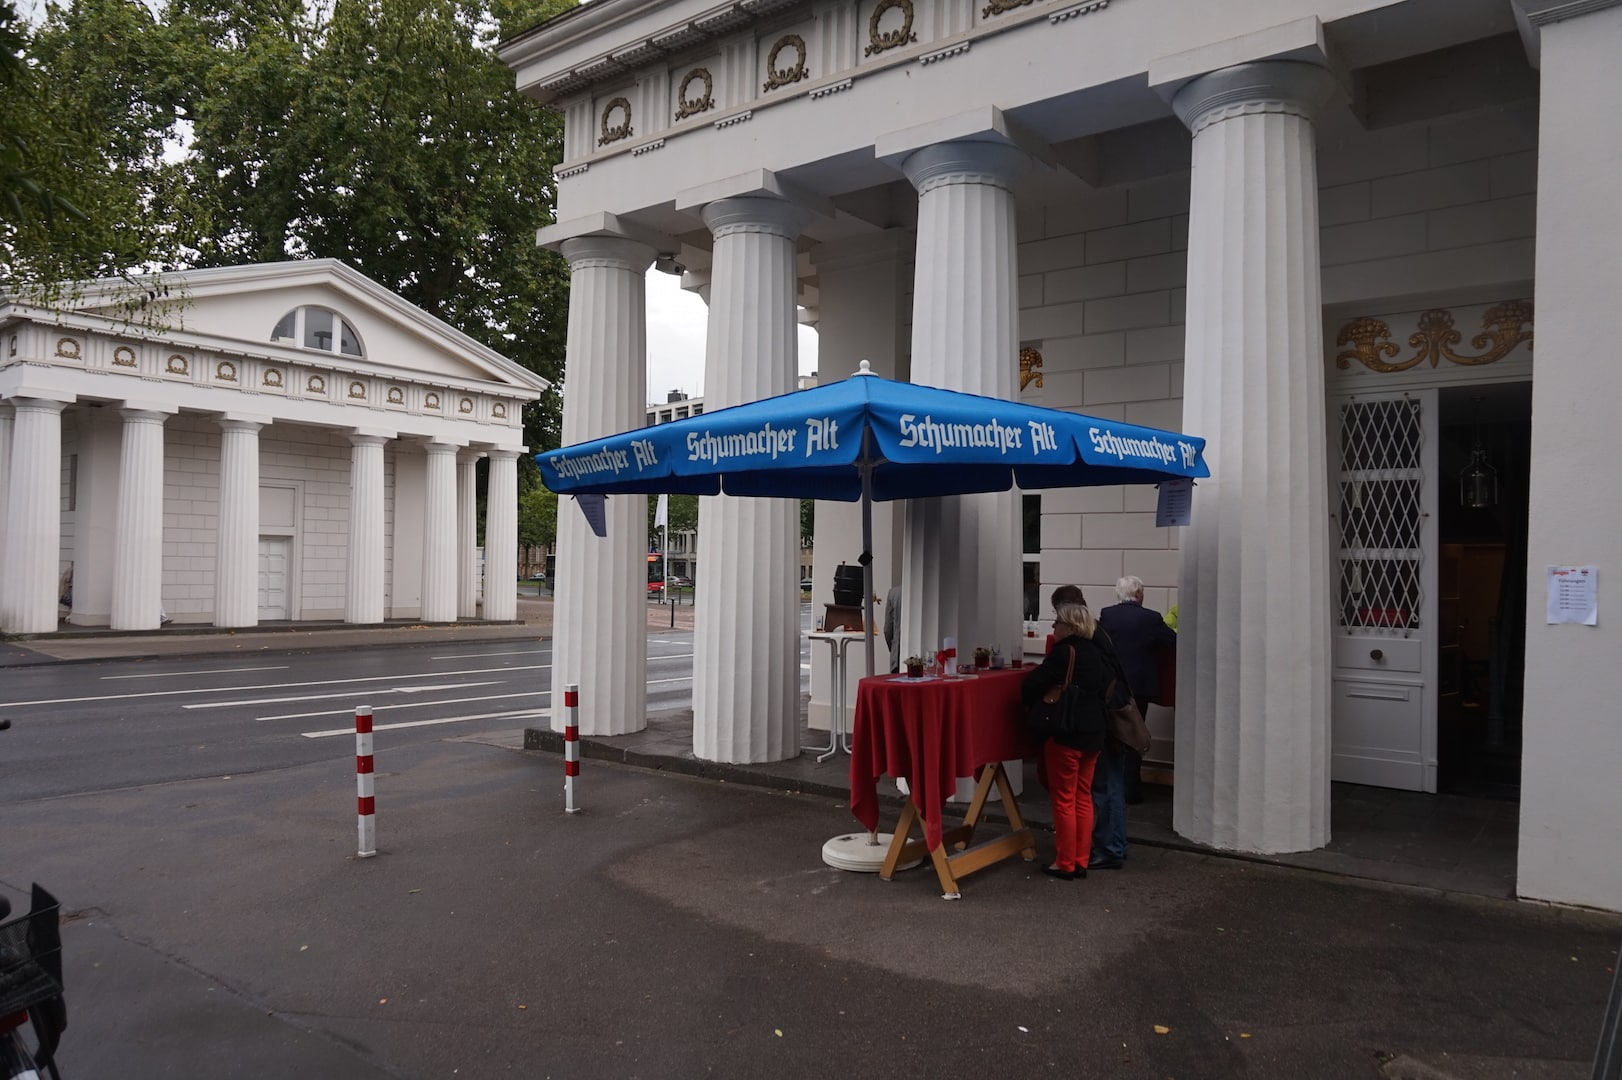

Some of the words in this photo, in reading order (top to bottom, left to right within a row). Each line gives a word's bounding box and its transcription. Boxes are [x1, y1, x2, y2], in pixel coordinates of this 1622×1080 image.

[687, 422, 797, 465] Schumacher
[805, 417, 839, 458] Alt
[899, 414, 1022, 455] Schumacher
[1028, 420, 1058, 456] Alt
[1089, 426, 1178, 464] Schumacher
[1177, 440, 1197, 470] Alt
[550, 445, 629, 481] Schumacher
[630, 439, 658, 472] Alt
